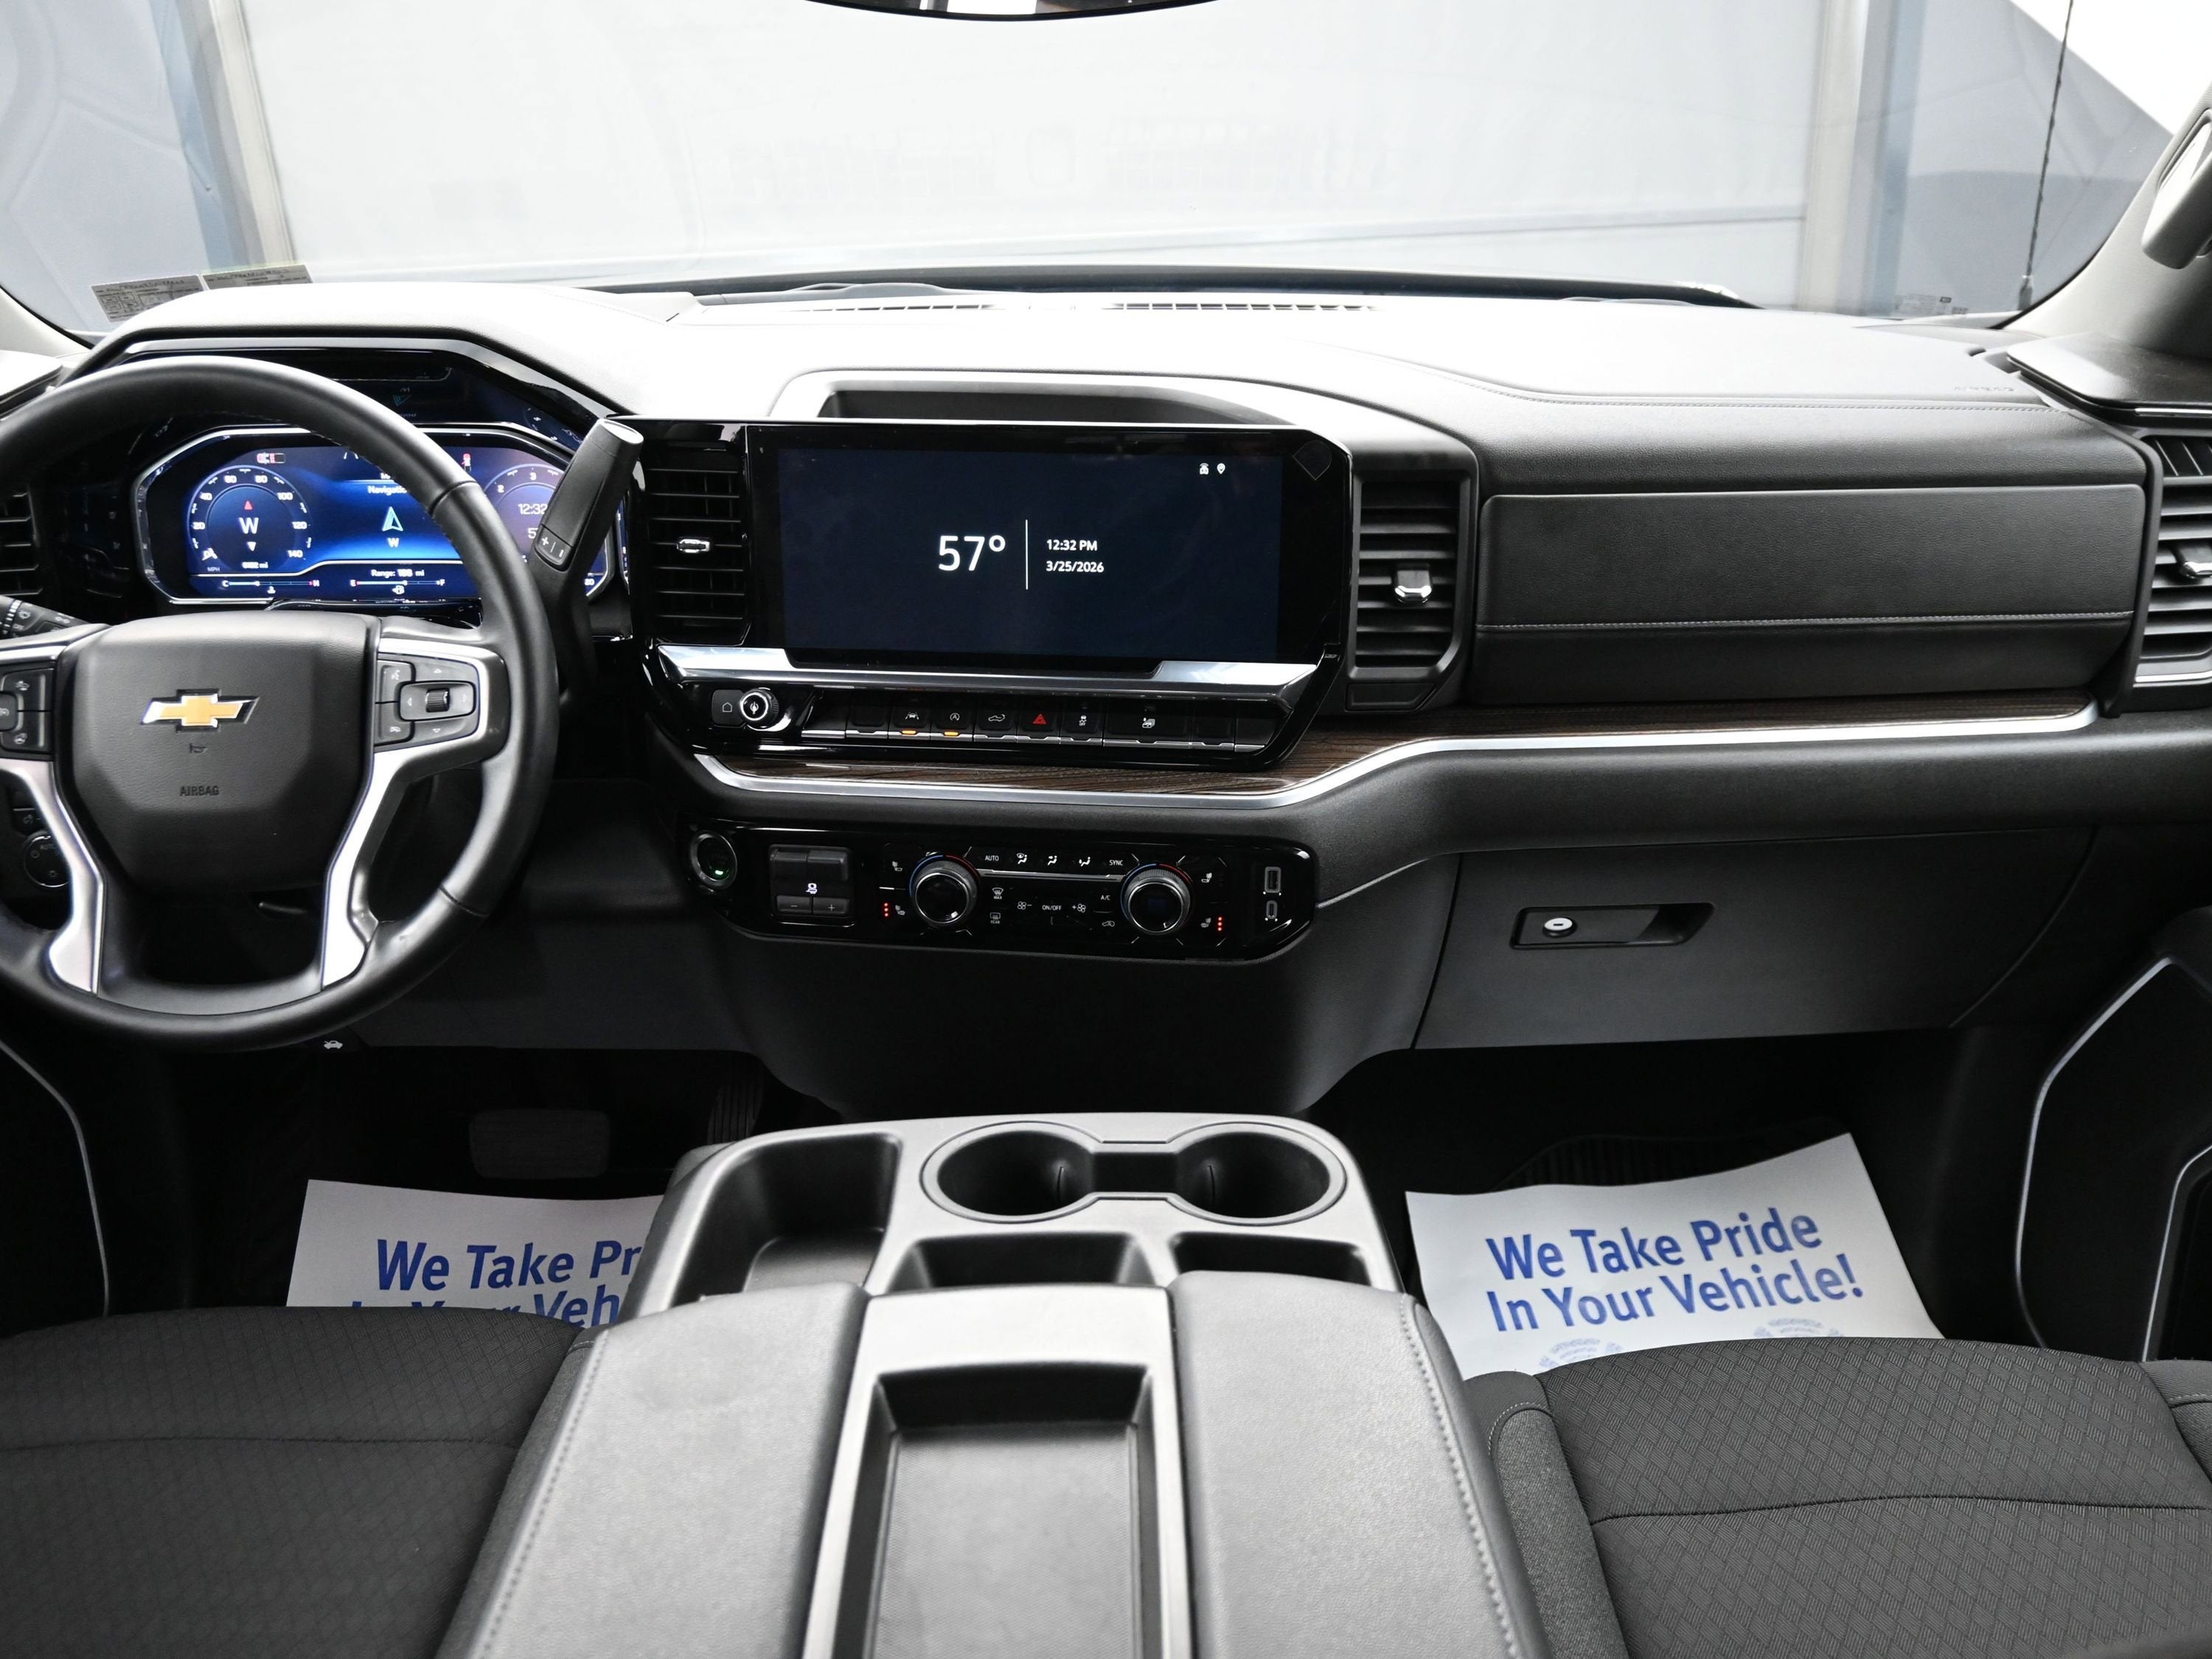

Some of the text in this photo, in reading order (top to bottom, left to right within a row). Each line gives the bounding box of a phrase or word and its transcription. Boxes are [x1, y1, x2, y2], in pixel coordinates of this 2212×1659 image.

[529, 472, 537, 481] 3
[497, 485, 504, 493] 2
[200, 492, 293, 501] 40 100
[518, 504, 548, 515] 12:32
[192, 521, 206, 529] 20
[239, 518, 259, 535] W
[387, 538, 399, 547] W
[1046, 539, 1098, 552] 12:32 PM
[1046, 560, 1105, 573] 3/25/2026
[371, 569, 396, 578] Range:
[179, 785, 220, 796] AIRBAG
[1486, 1207, 1822, 1281] We Take Pride
[377, 1239, 450, 1291] We
[466, 1242, 574, 1289] Take
[1486, 1253, 1864, 1333] In Your Vehicle!
